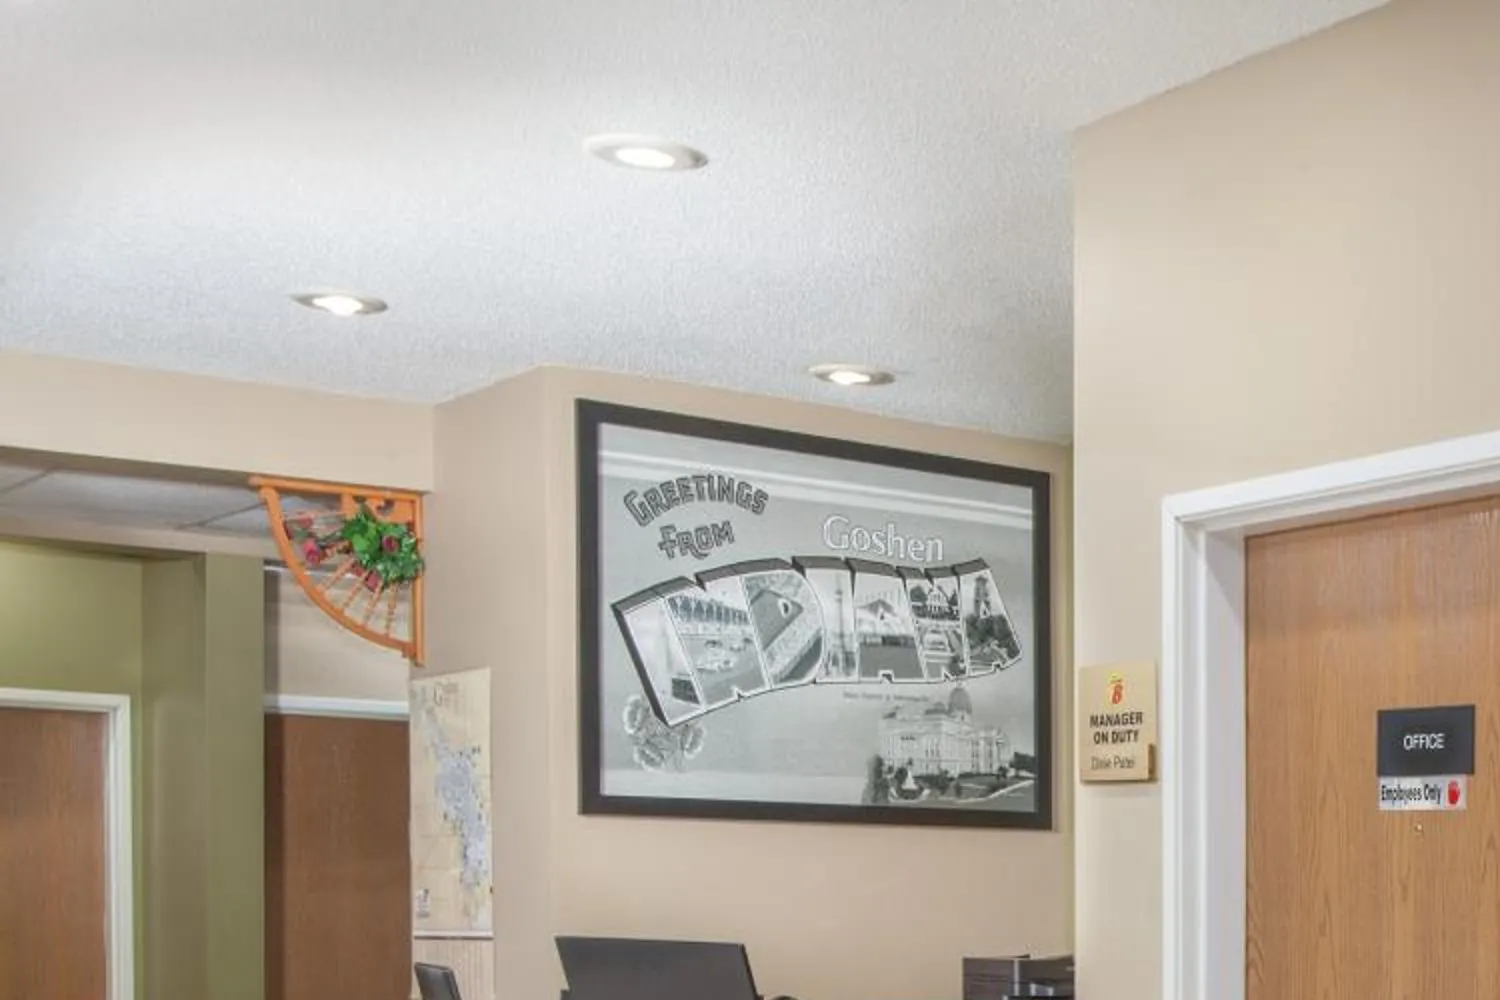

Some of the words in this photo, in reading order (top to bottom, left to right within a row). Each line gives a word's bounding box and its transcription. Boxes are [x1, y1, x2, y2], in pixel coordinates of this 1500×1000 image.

[623, 473, 769, 527] GREETINGS
[658, 519, 736, 561] FROM
[822, 514, 944, 562] Goshen
[1089, 711, 1143, 727] MANAGER
[1093, 730, 1109, 744] ON
[1111, 729, 1139, 743] DUTY
[1403, 733, 1445, 750] OFFICE
[1381, 784, 1422, 804] Employees
[1423, 783, 1441, 804] Only
